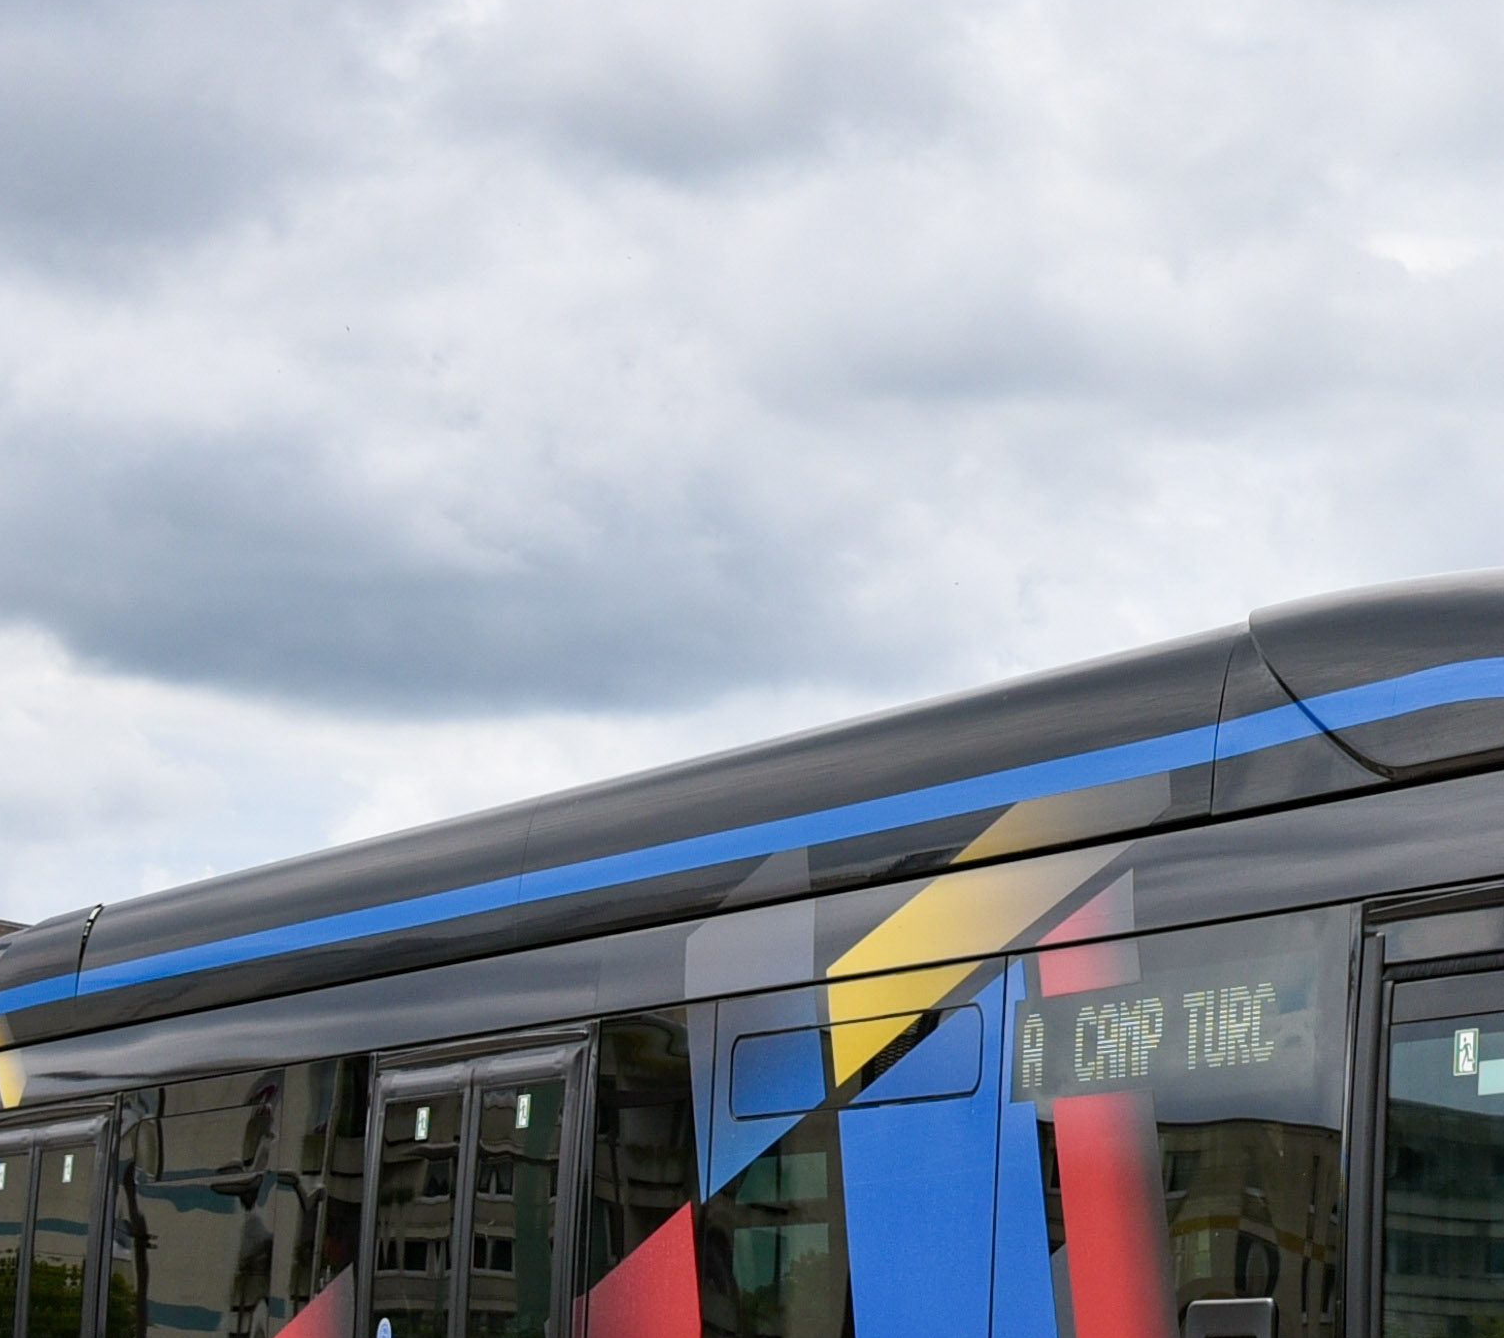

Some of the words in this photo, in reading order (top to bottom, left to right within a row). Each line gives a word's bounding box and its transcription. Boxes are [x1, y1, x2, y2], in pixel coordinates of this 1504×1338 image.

[1022, 1013, 1044, 1088] A
[1074, 997, 1163, 1082] CAMP
[1183, 982, 1276, 1070] TURC
